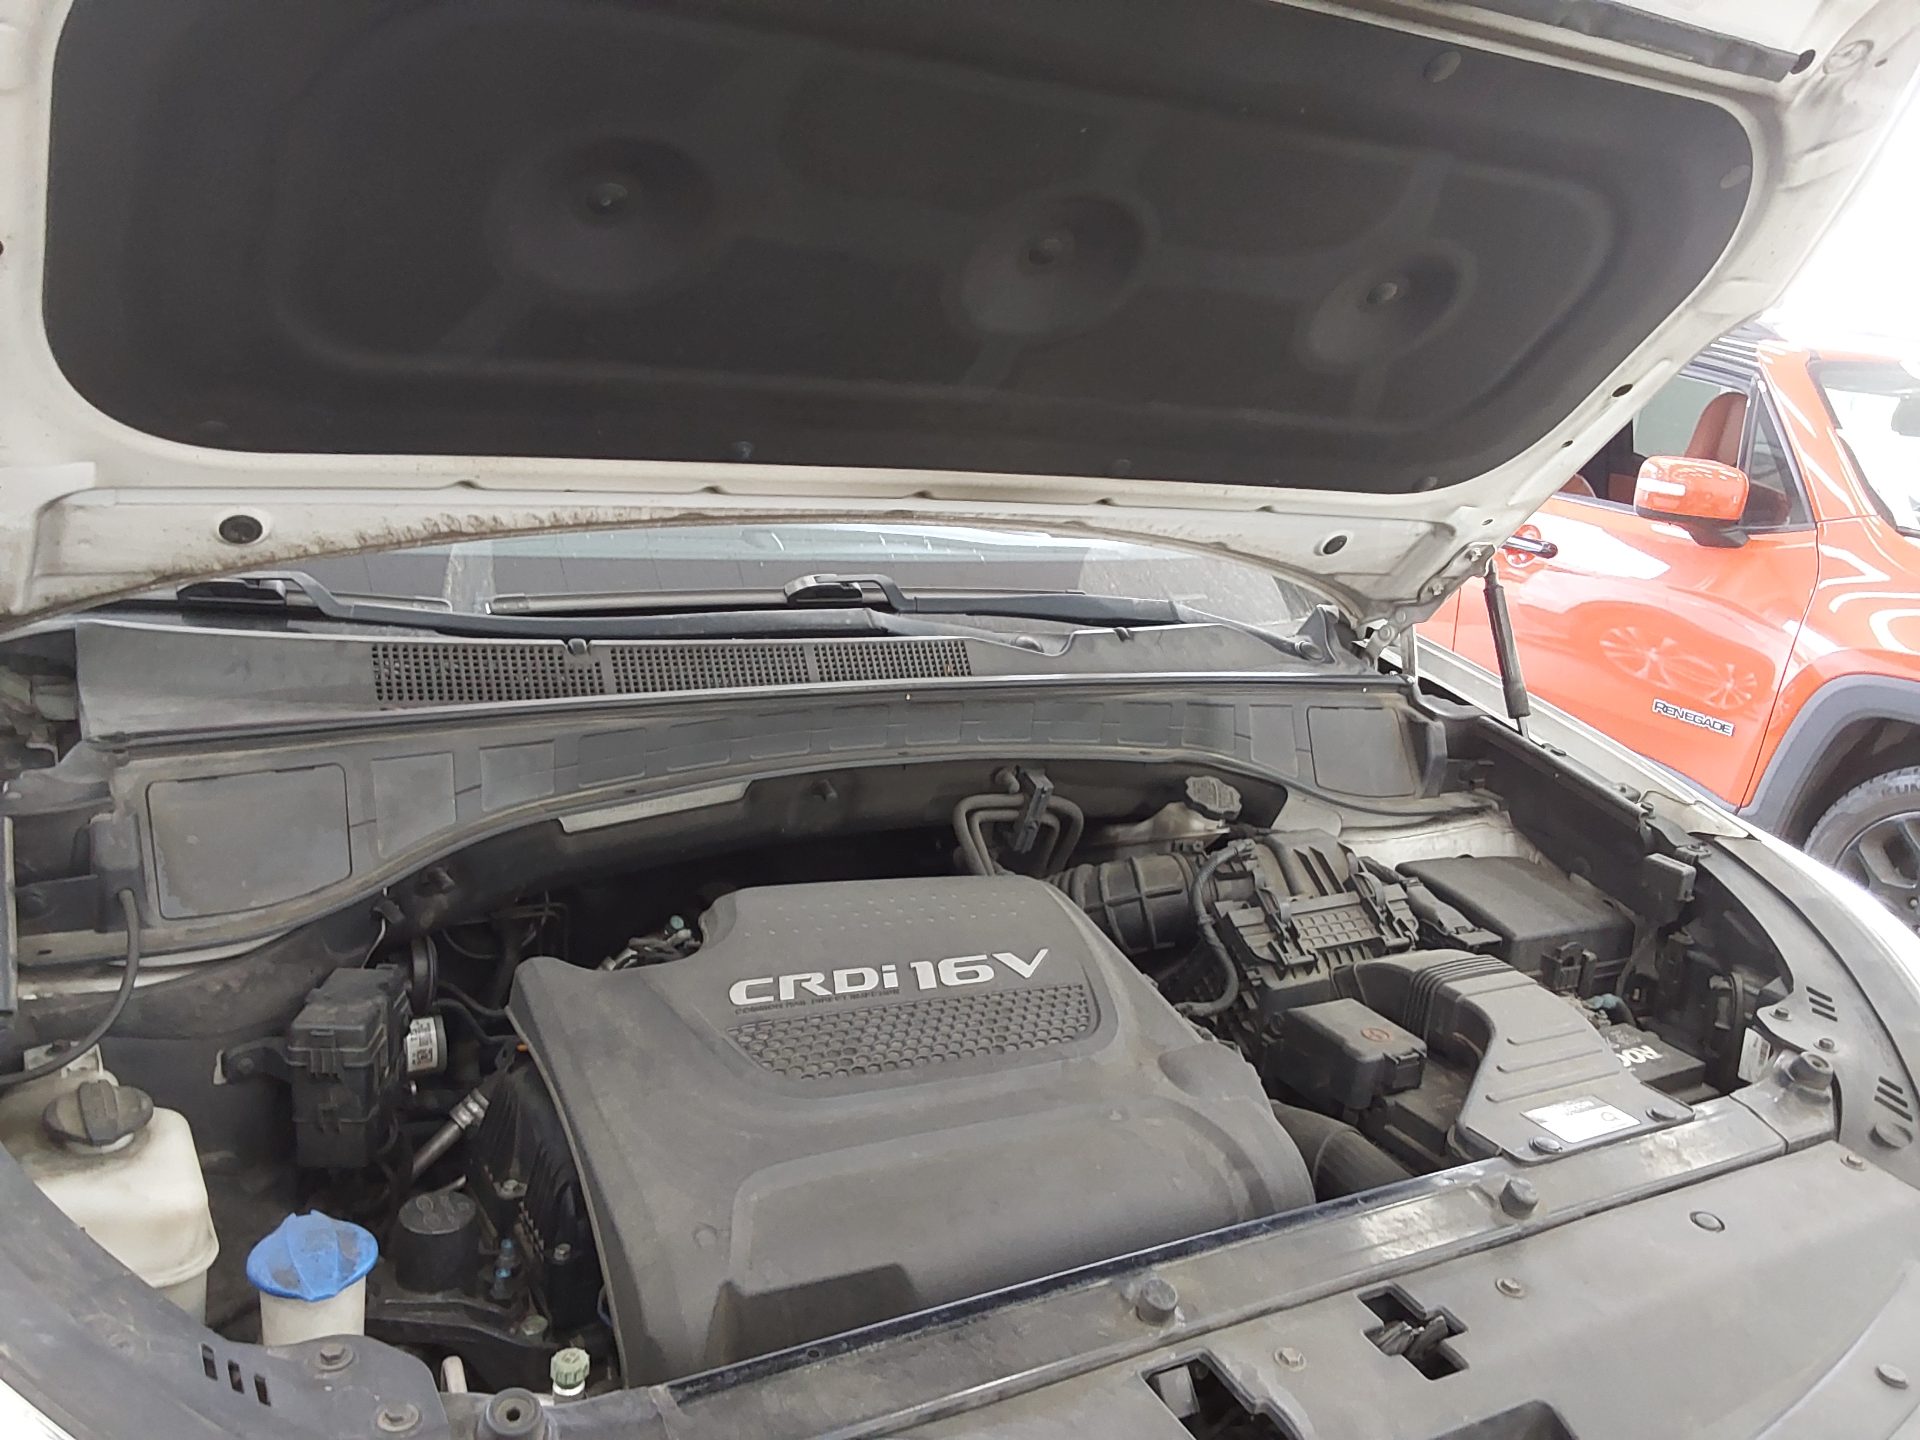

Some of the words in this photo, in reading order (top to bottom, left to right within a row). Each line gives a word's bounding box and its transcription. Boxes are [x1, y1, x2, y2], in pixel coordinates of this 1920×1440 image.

[1654, 700, 1733, 735] RENEGADE
[729, 964, 899, 1005] CRDi
[909, 949, 1048, 990] 16V
